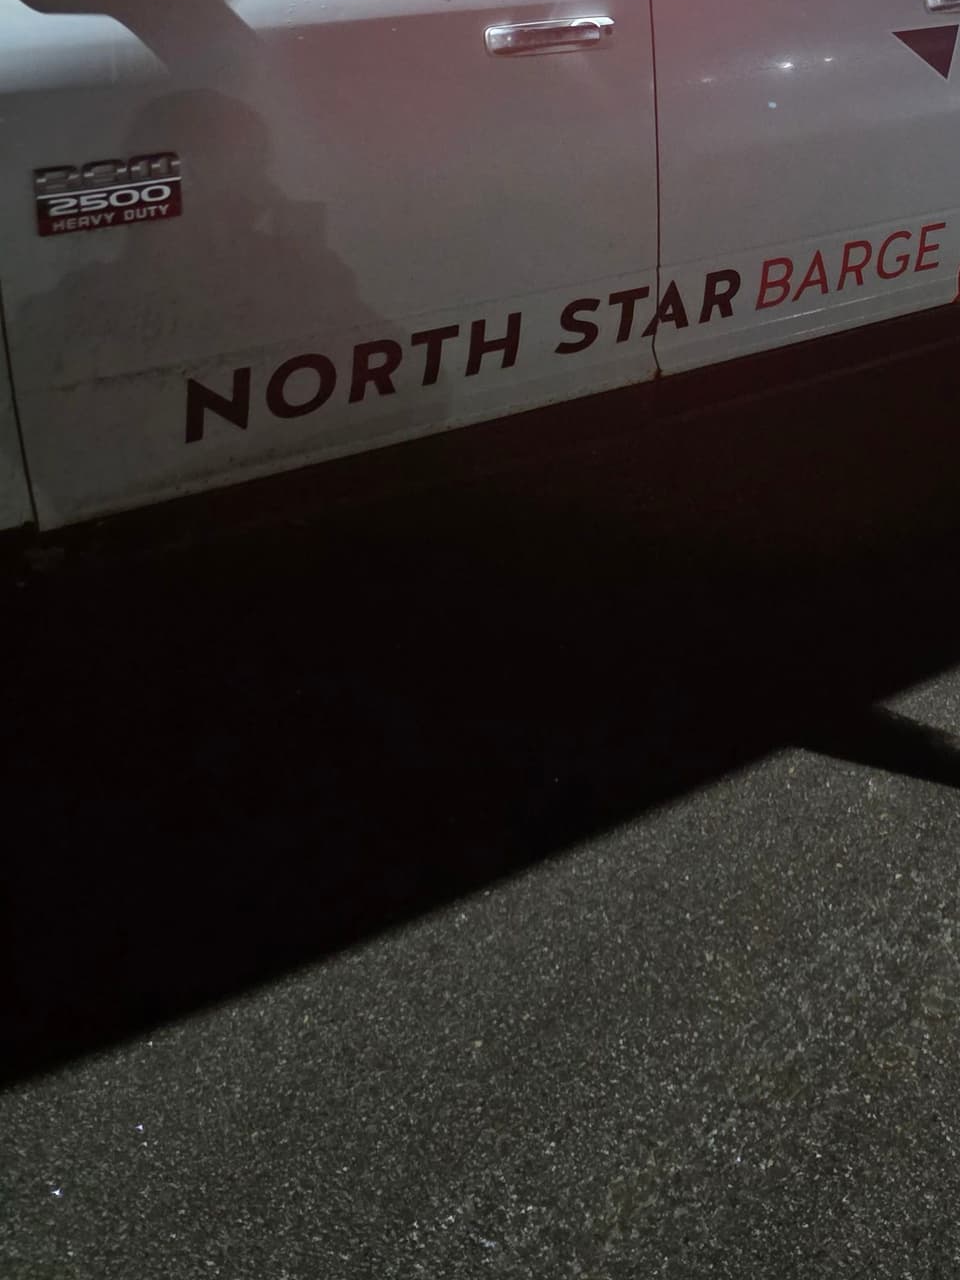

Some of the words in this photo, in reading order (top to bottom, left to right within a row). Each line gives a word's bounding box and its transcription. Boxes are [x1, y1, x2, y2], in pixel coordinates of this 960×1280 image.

[48, 185, 171, 217] 2500
[52, 212, 115, 232] HEAVY
[124, 204, 170, 222] DUTY
[184, 312, 522, 444] NORTH
[555, 269, 741, 354] STAR
[755, 222, 947, 310] BARGE
